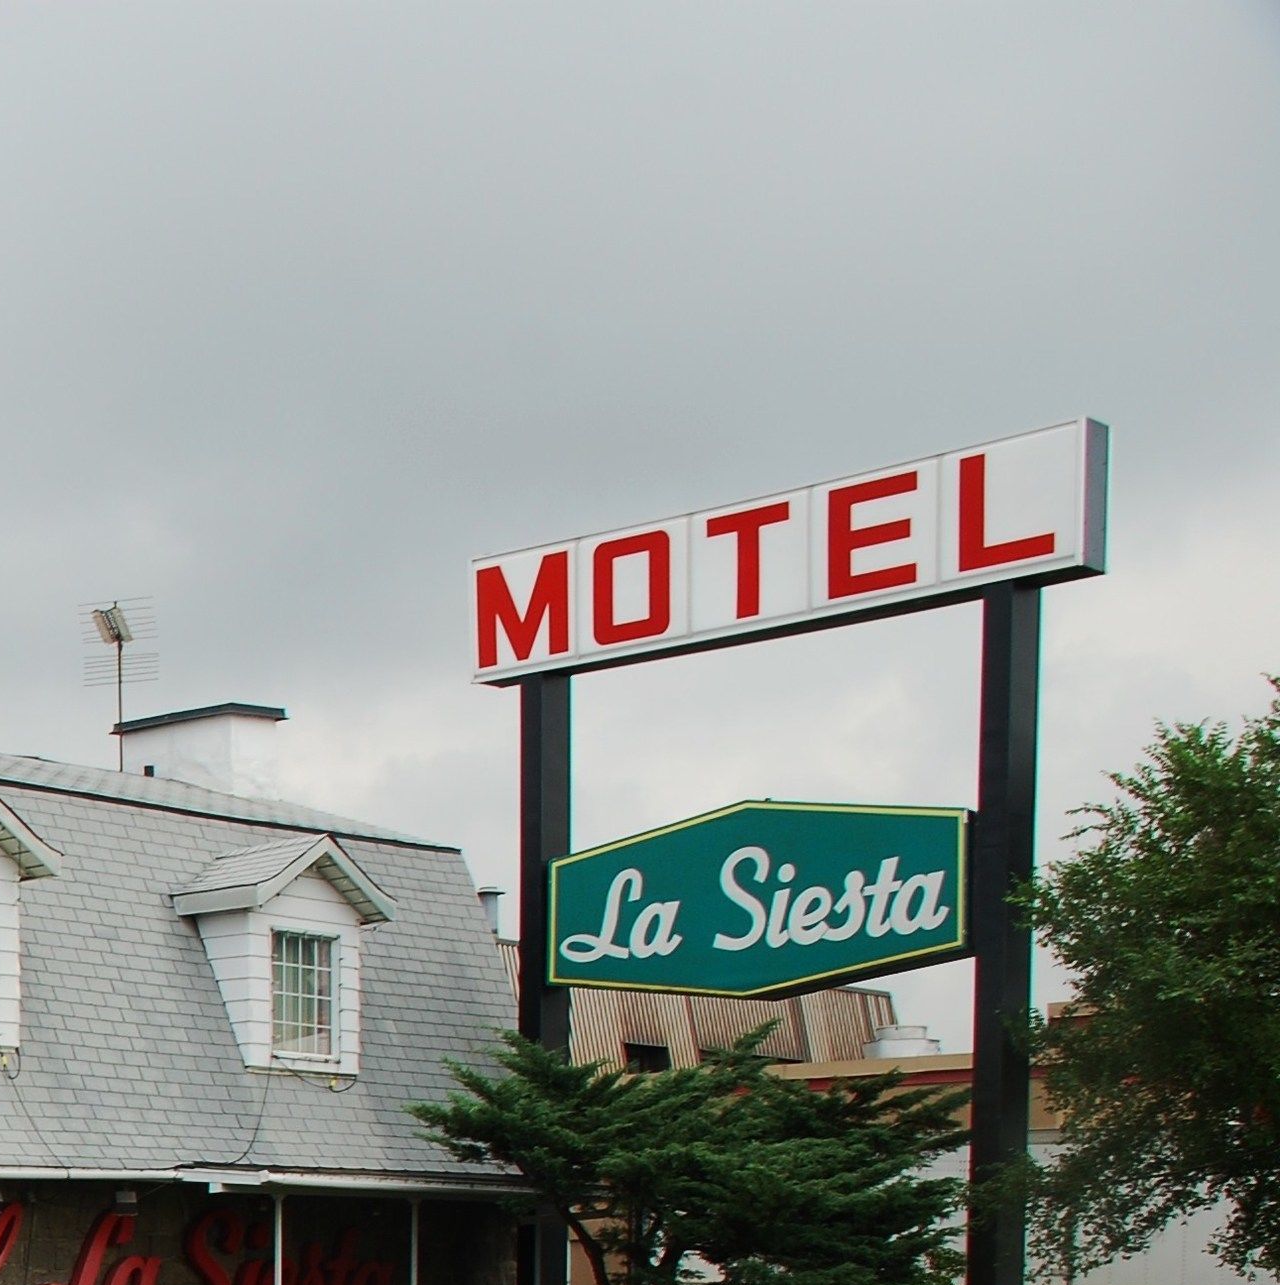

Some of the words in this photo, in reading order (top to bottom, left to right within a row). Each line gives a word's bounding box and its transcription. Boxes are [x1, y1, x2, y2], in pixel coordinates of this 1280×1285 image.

[476, 453, 1056, 669] MOTEL
[559, 867, 683, 963] La
[712, 845, 951, 952] Siesta
